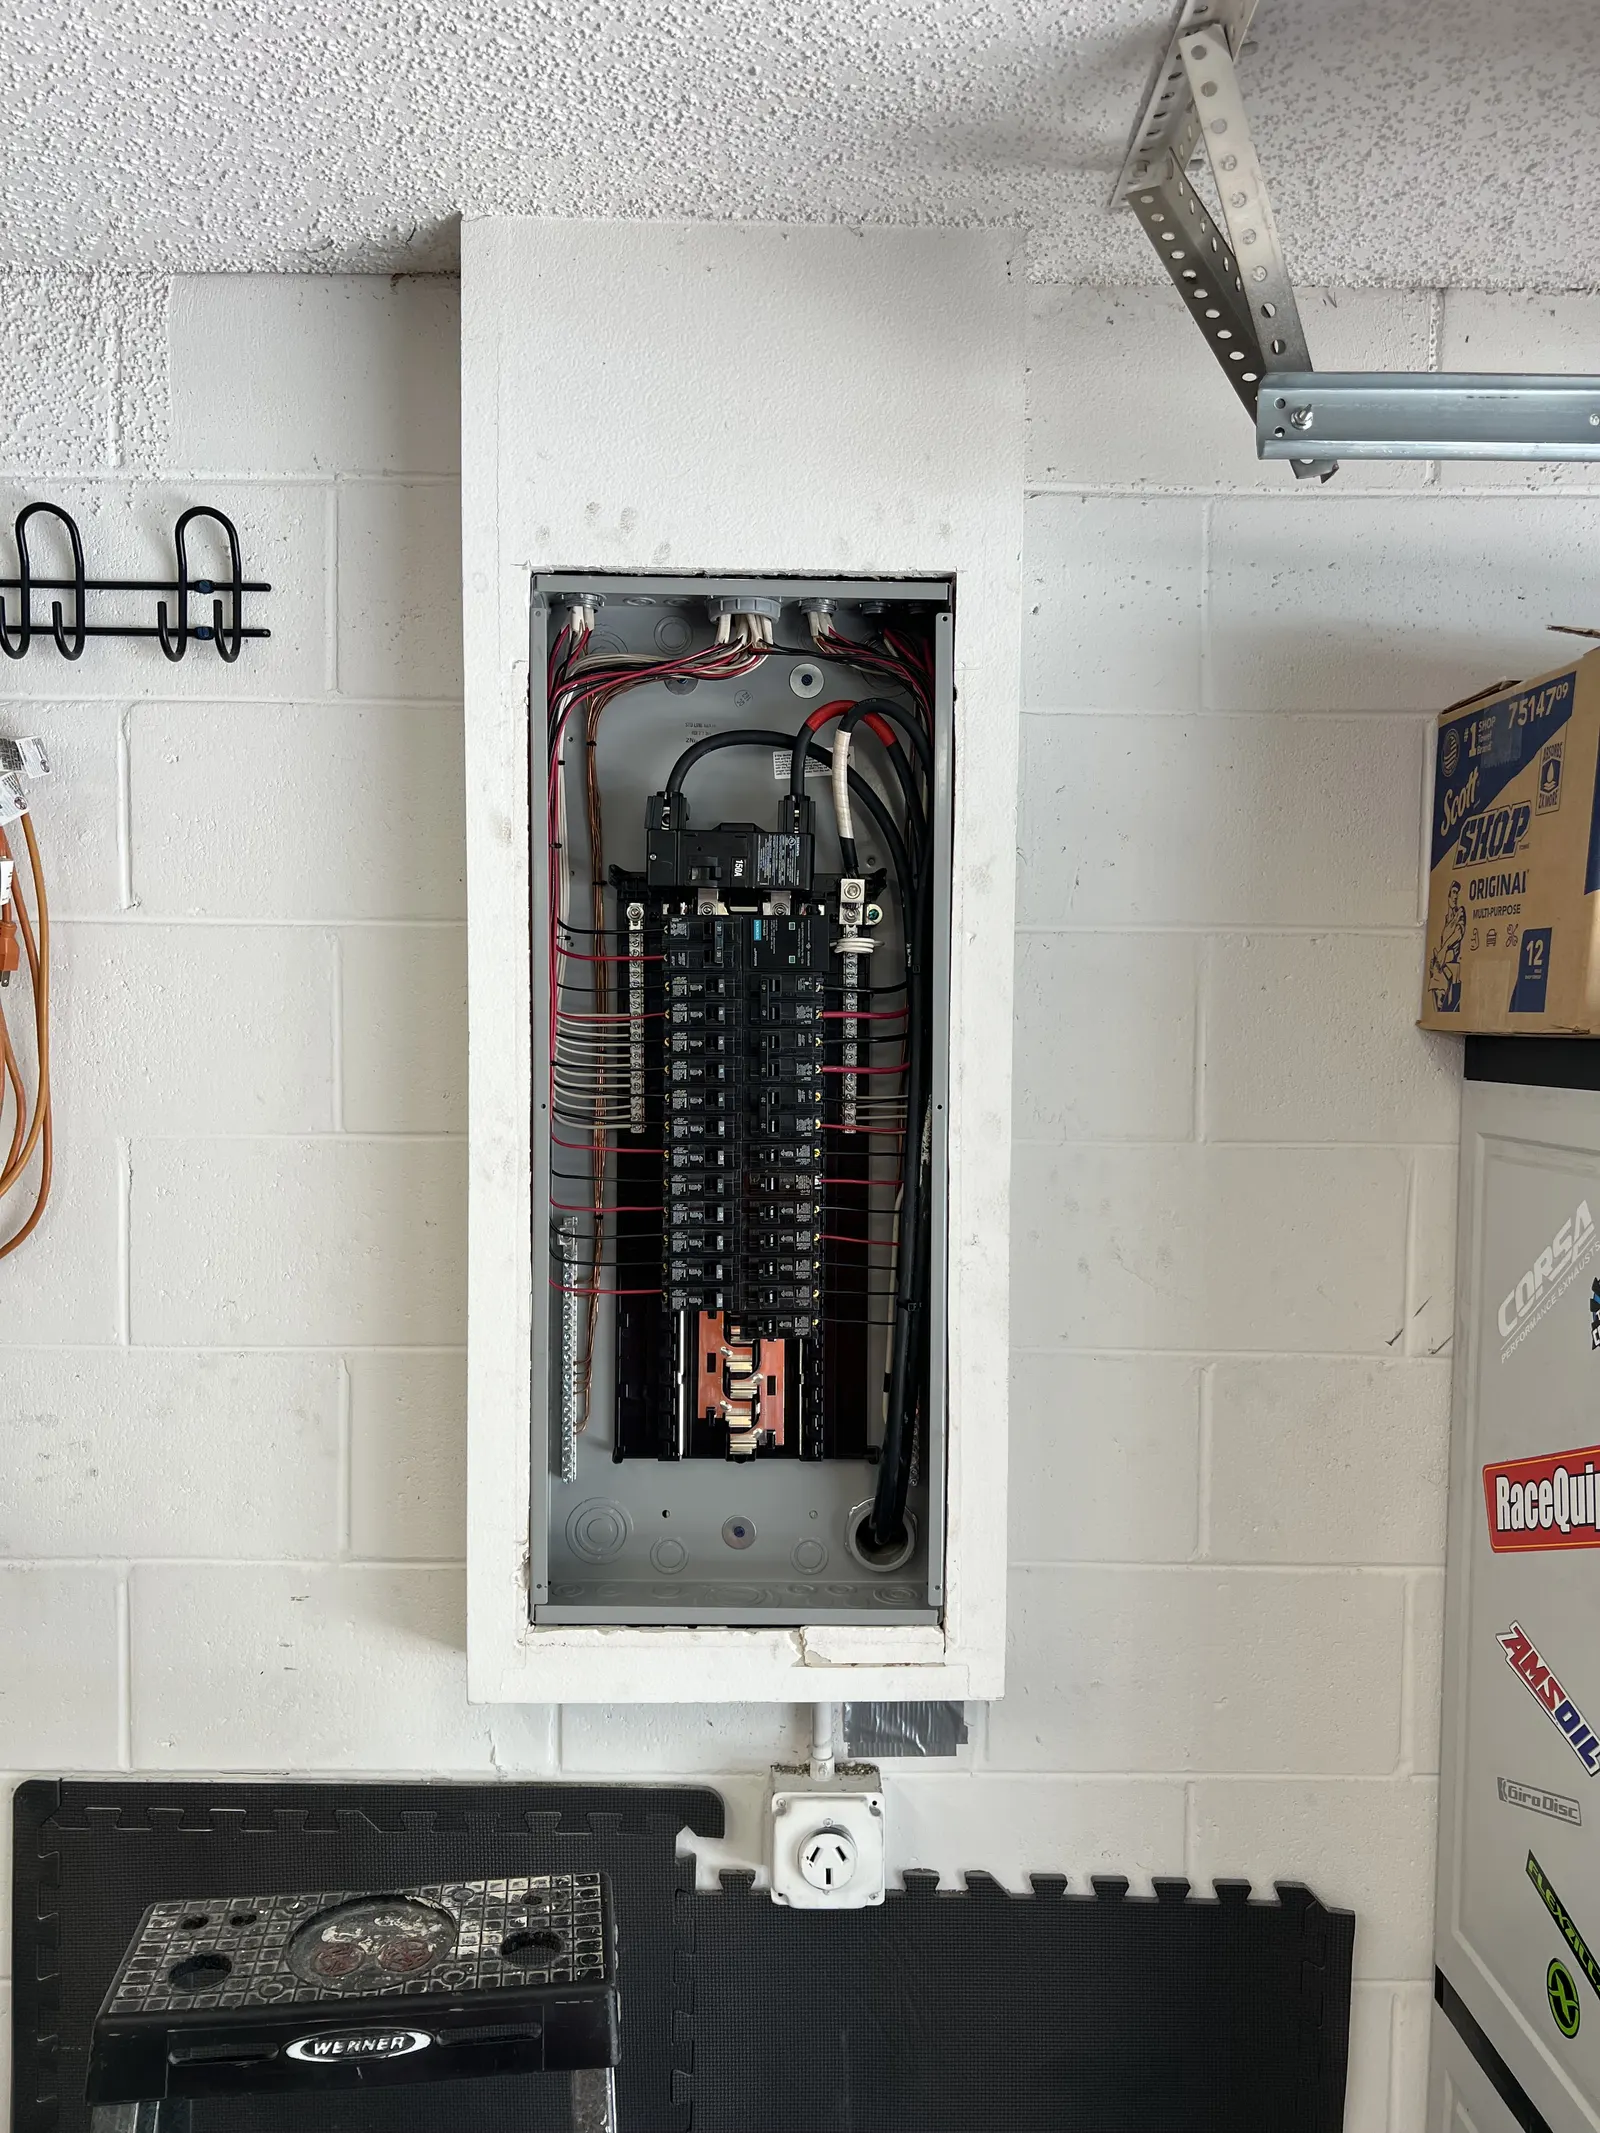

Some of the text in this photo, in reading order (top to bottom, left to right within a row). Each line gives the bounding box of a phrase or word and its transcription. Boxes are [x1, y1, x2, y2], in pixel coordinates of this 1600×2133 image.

[1478, 716, 1496, 733] SHOP
[1441, 766, 1479, 837] Scott
[1454, 801, 1531, 868] SHOP
[733, 859, 744, 878] 150A
[1473, 904, 1521, 920] MULTI-PURPOSE
[1526, 939, 1544, 966] 12
[1498, 1200, 1595, 1337] CORSA
[1501, 1240, 1600, 1364] PERFORMANCE EXHAUSTS
[1501, 1625, 1599, 1769] AMSOIL
[314, 2036, 405, 2055] WERNER
